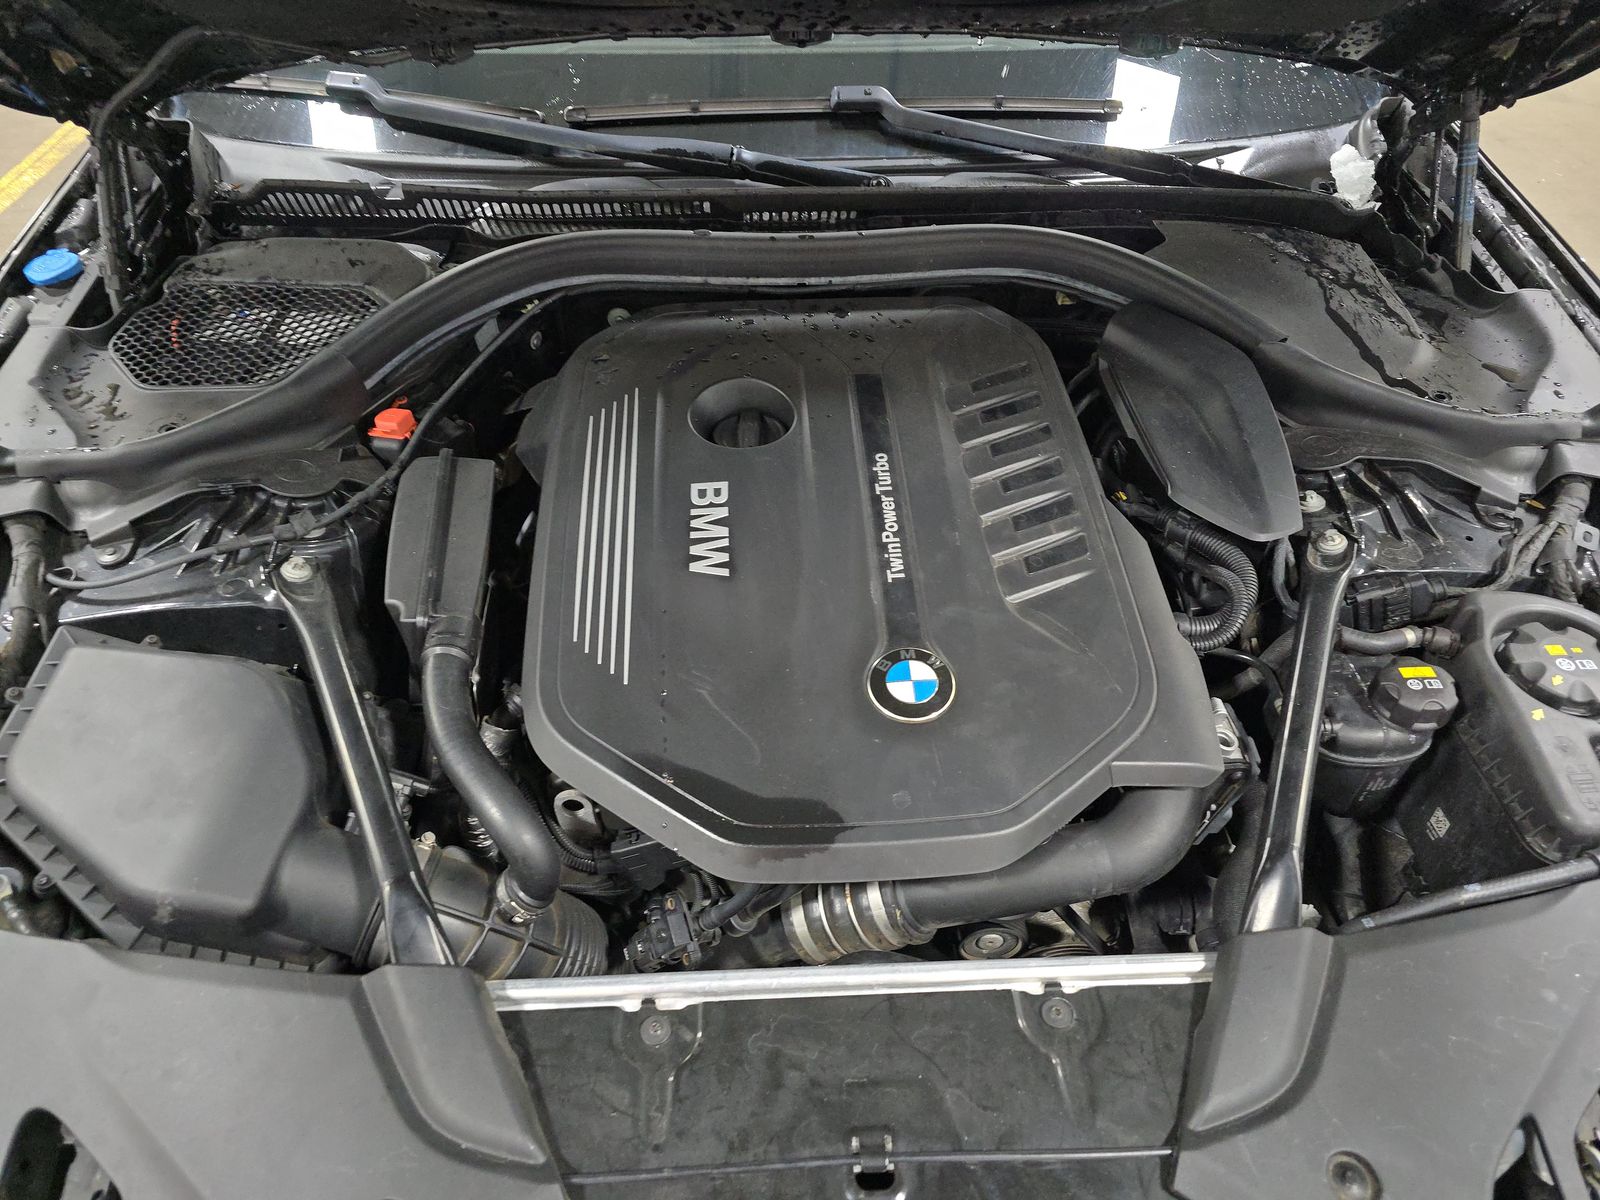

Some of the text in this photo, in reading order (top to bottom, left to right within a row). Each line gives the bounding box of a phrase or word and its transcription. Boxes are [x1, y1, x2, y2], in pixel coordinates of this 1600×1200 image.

[688, 480, 731, 577] BMW
[872, 452, 906, 583] TwinPower Turbo
[876, 649, 945, 671] BMW
